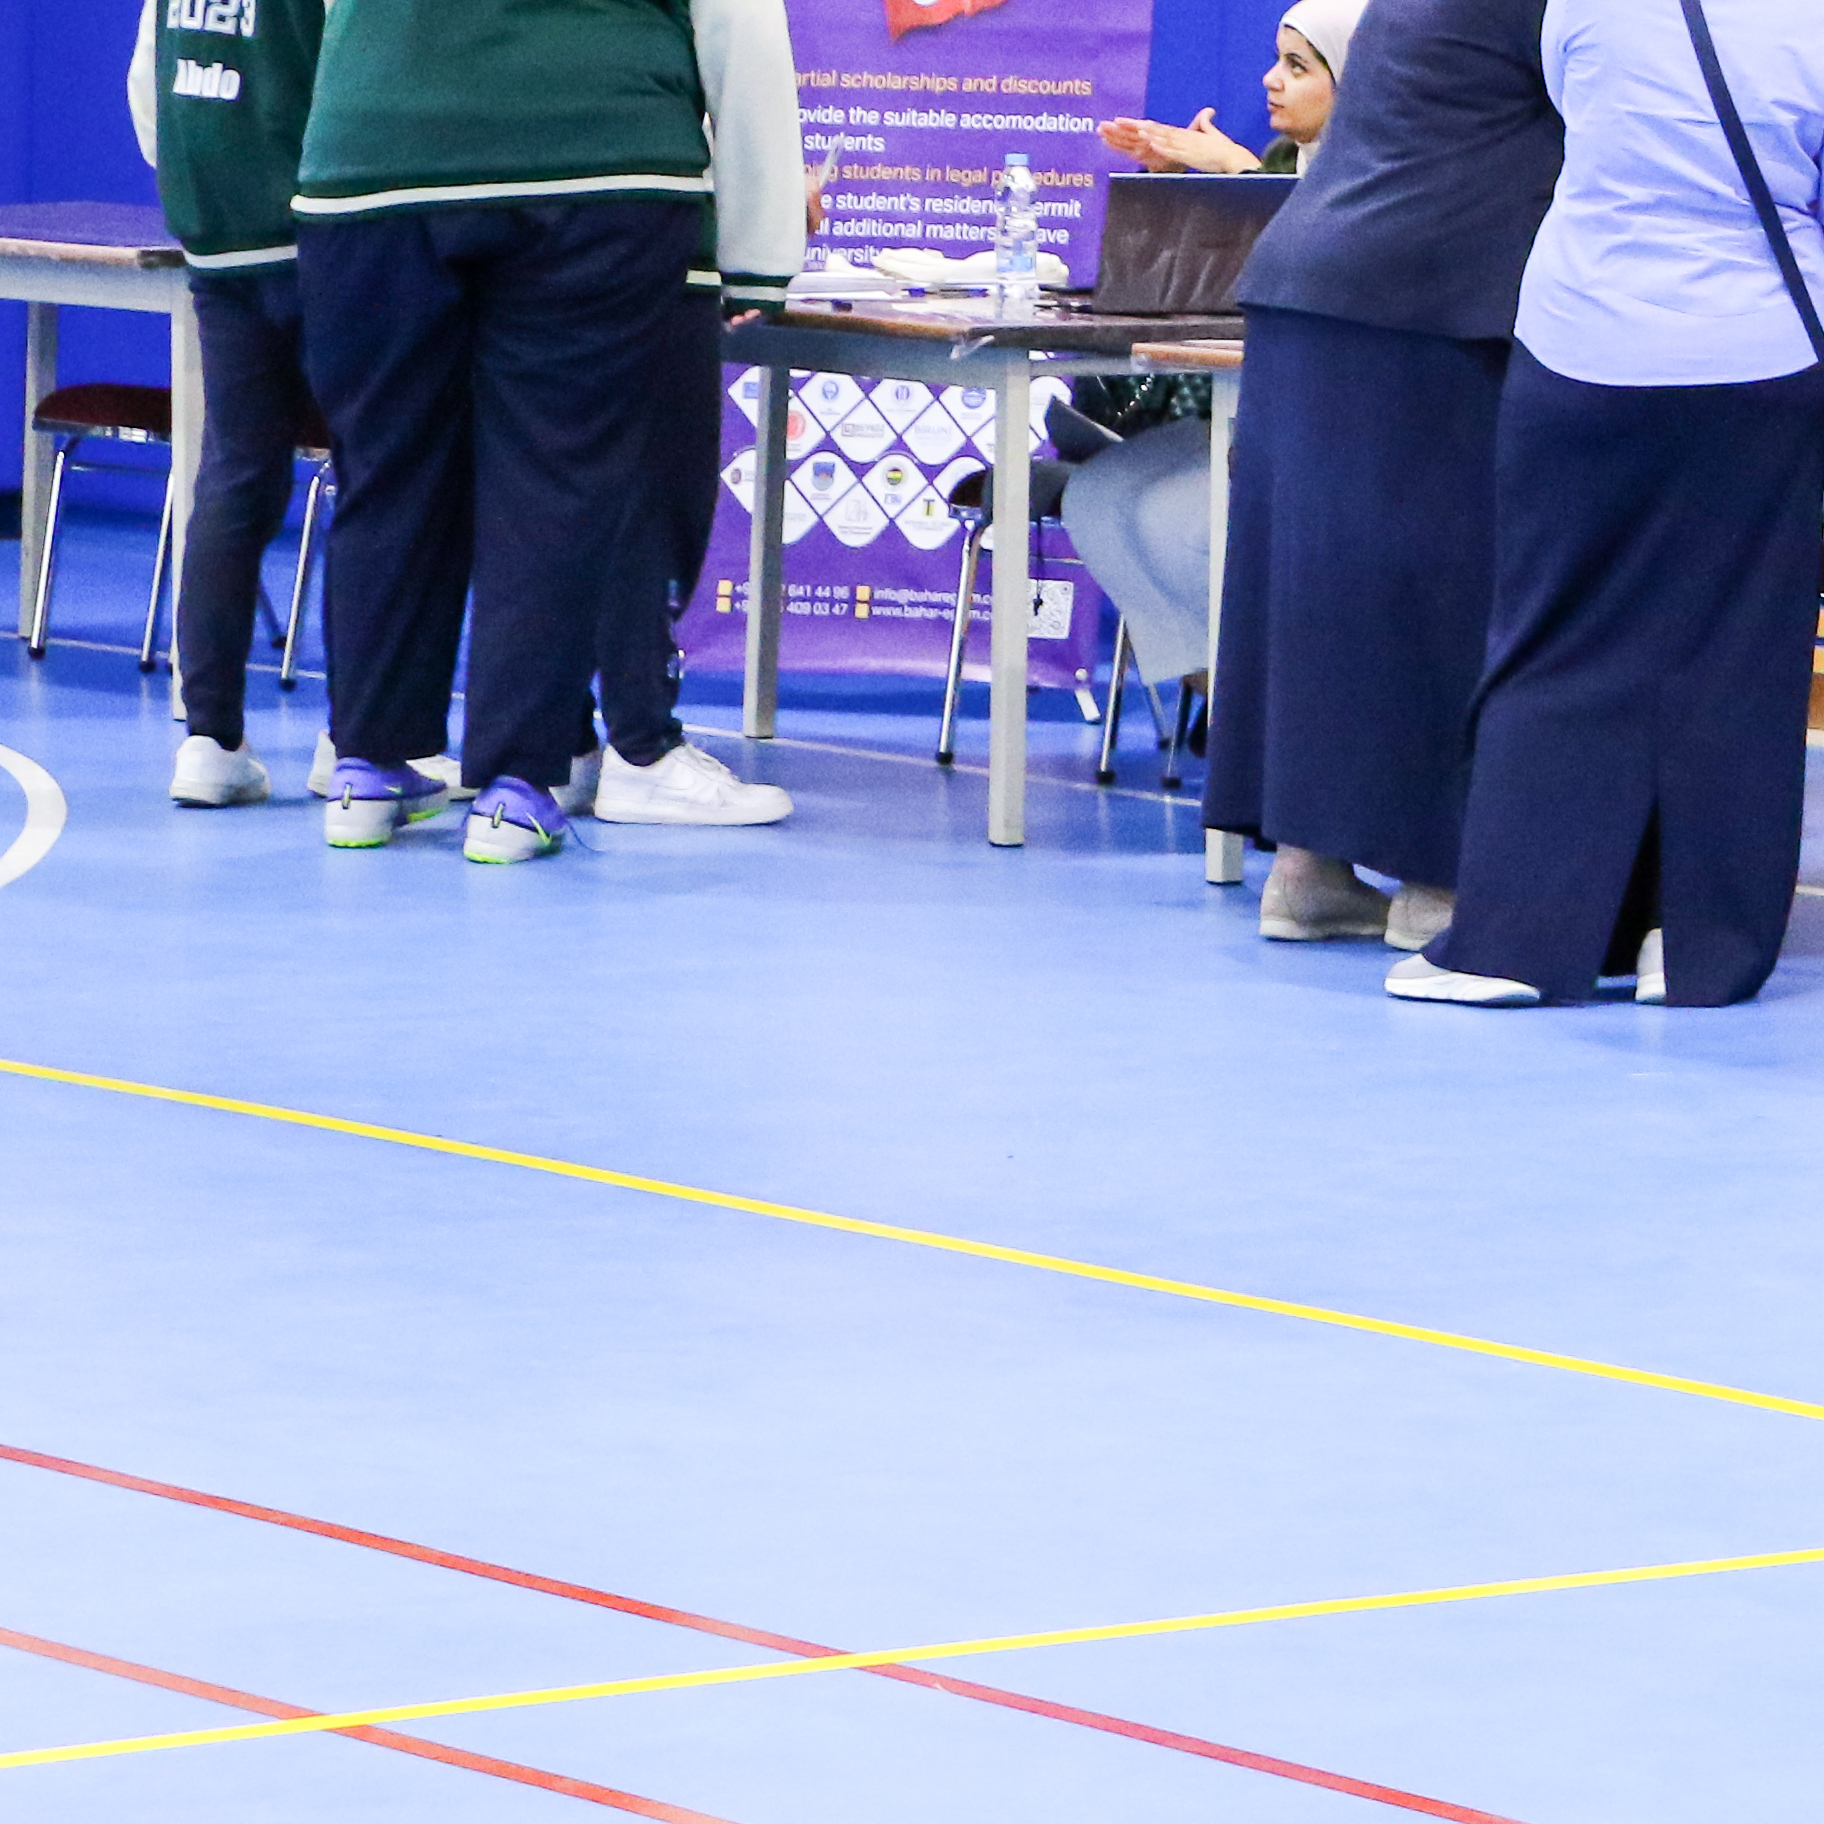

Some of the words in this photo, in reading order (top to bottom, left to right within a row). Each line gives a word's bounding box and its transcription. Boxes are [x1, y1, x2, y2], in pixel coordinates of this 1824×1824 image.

[796, 70, 836, 86] artial
[840, 71, 958, 95] scholarships
[962, 74, 996, 93] and
[1001, 75, 1092, 96] discounts
[797, 104, 845, 124] ovide
[848, 105, 879, 125] the
[883, 107, 956, 128] suitable
[960, 111, 1094, 133] accomodation
[842, 161, 922, 181] students
[925, 163, 941, 181] in
[945, 164, 988, 188] legal
[990, 167, 1094, 189] pedures
[835, 191, 922, 212] student's
[924, 194, 1003, 213] residen
[1034, 197, 1082, 218] ermit
[833, 218, 922, 239] additional
[926, 220, 998, 243] matters
[1036, 228, 1070, 246] ave
